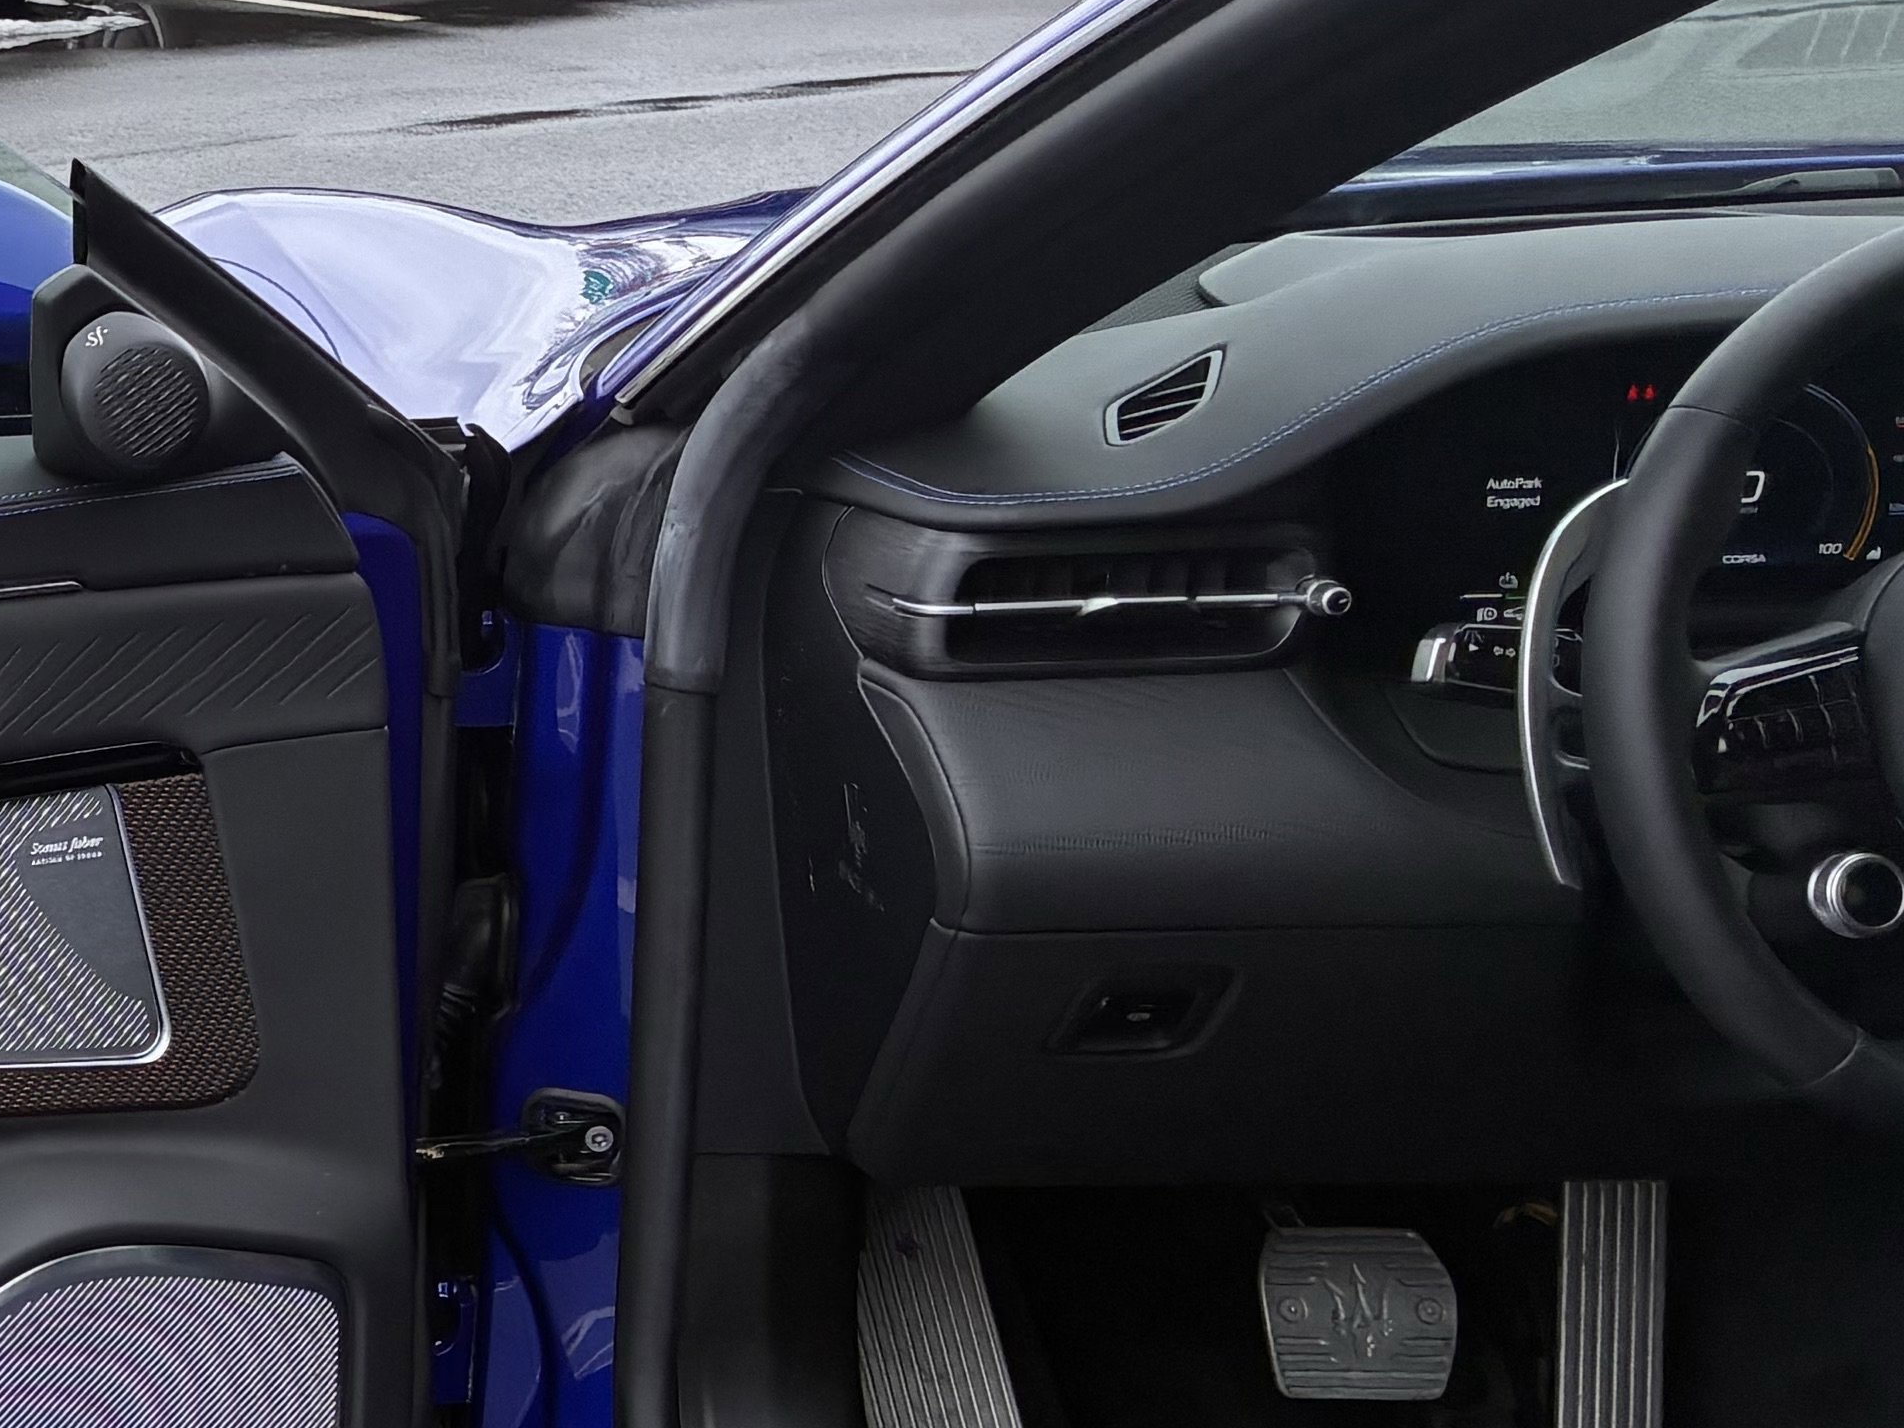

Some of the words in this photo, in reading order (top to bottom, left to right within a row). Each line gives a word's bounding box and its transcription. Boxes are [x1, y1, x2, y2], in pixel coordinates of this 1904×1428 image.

[1486, 476, 1543, 490] AutoPark
[1486, 494, 1541, 510] Engaged
[1818, 542, 1842, 555] 100
[1721, 553, 1767, 565] CORSA
